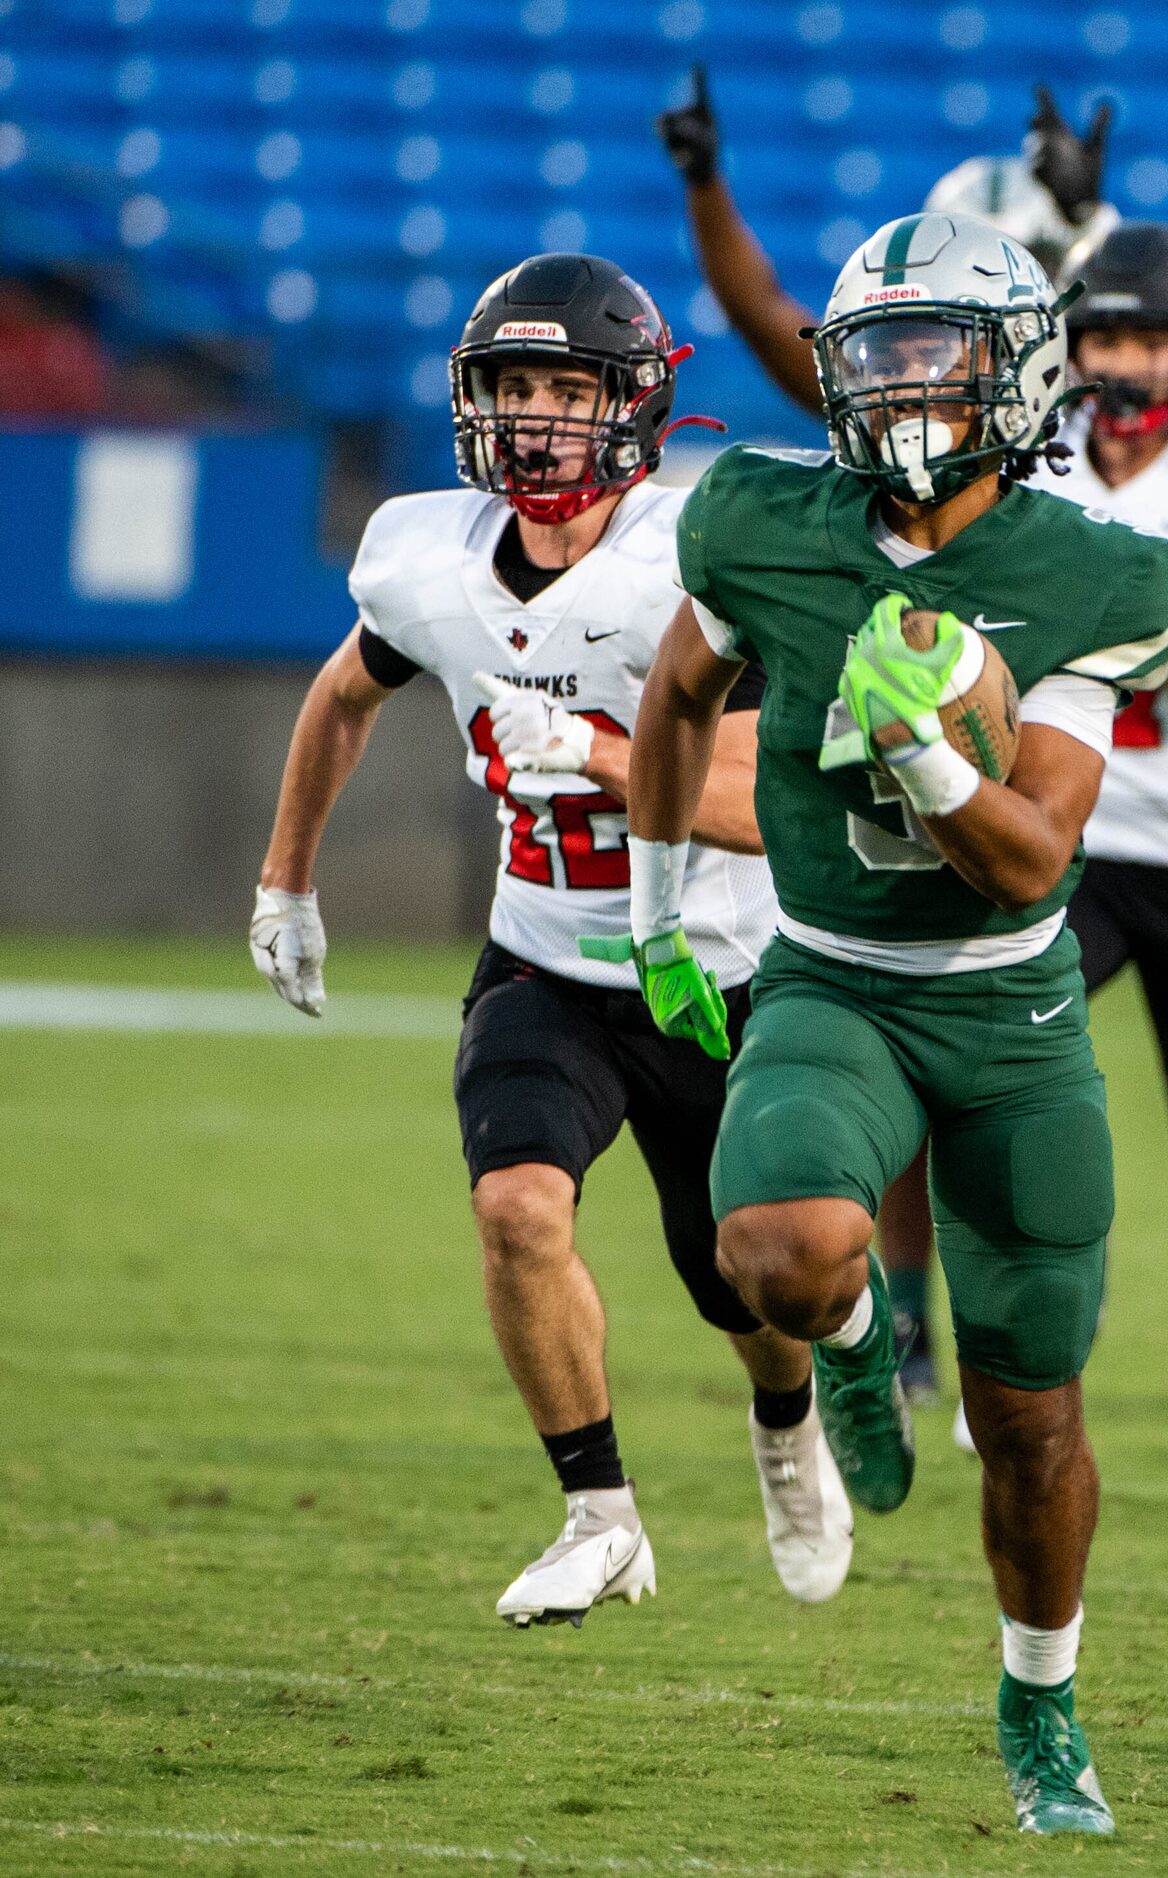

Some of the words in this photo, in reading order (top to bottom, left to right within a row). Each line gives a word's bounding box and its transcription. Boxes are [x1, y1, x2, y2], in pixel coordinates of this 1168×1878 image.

[863, 288, 921, 305] Riddell
[502, 325, 557, 338] Riddell
[494, 673, 578, 698] HAWKS
